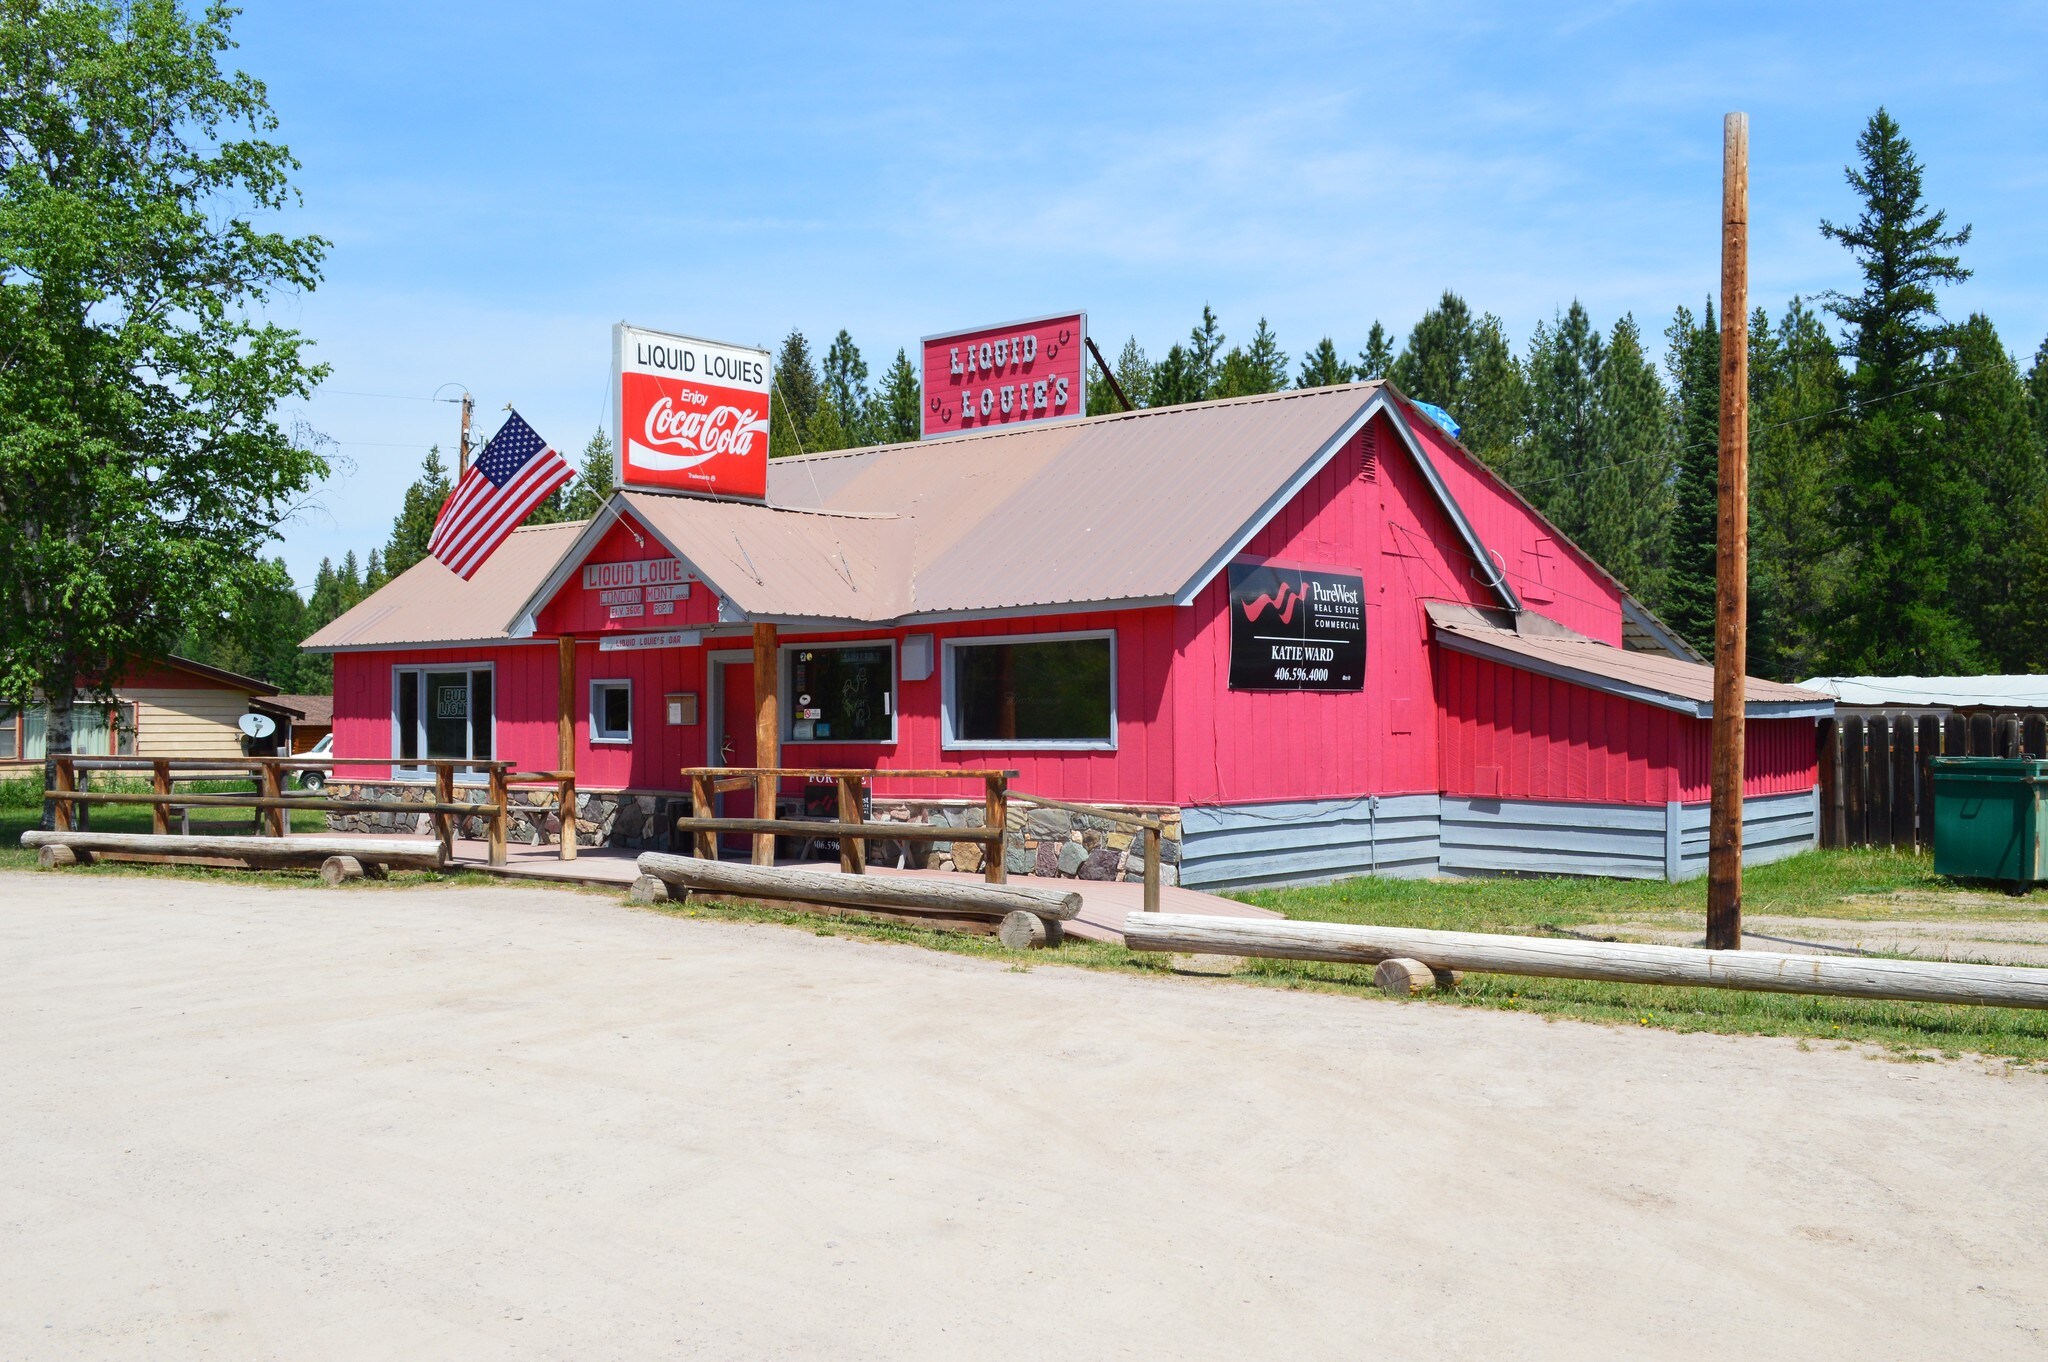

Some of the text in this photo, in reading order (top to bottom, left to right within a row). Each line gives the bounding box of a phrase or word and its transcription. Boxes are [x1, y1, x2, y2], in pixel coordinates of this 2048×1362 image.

[950, 335, 1038, 375] LIQUID
[638, 343, 763, 385] LIQUID LOUIES
[681, 388, 709, 406] Enjoy
[961, 373, 1069, 418] LOUIE'S
[645, 397, 759, 456] Coca-Cola
[589, 560, 696, 587] LIQUID LOUIE
[600, 589, 640, 605] CONDON
[1312, 581, 1359, 604] PureWest
[1314, 604, 1360, 615] REAL ESTATE
[1315, 619, 1360, 631] COMMERCIAL
[615, 637, 636, 648] LIQUID
[639, 636, 665, 646] LOUIE'S
[1271, 645, 1334, 662] KATIE WARD
[1275, 668, 1328, 681] 406.596.4000
[444, 689, 467, 702] BUD
